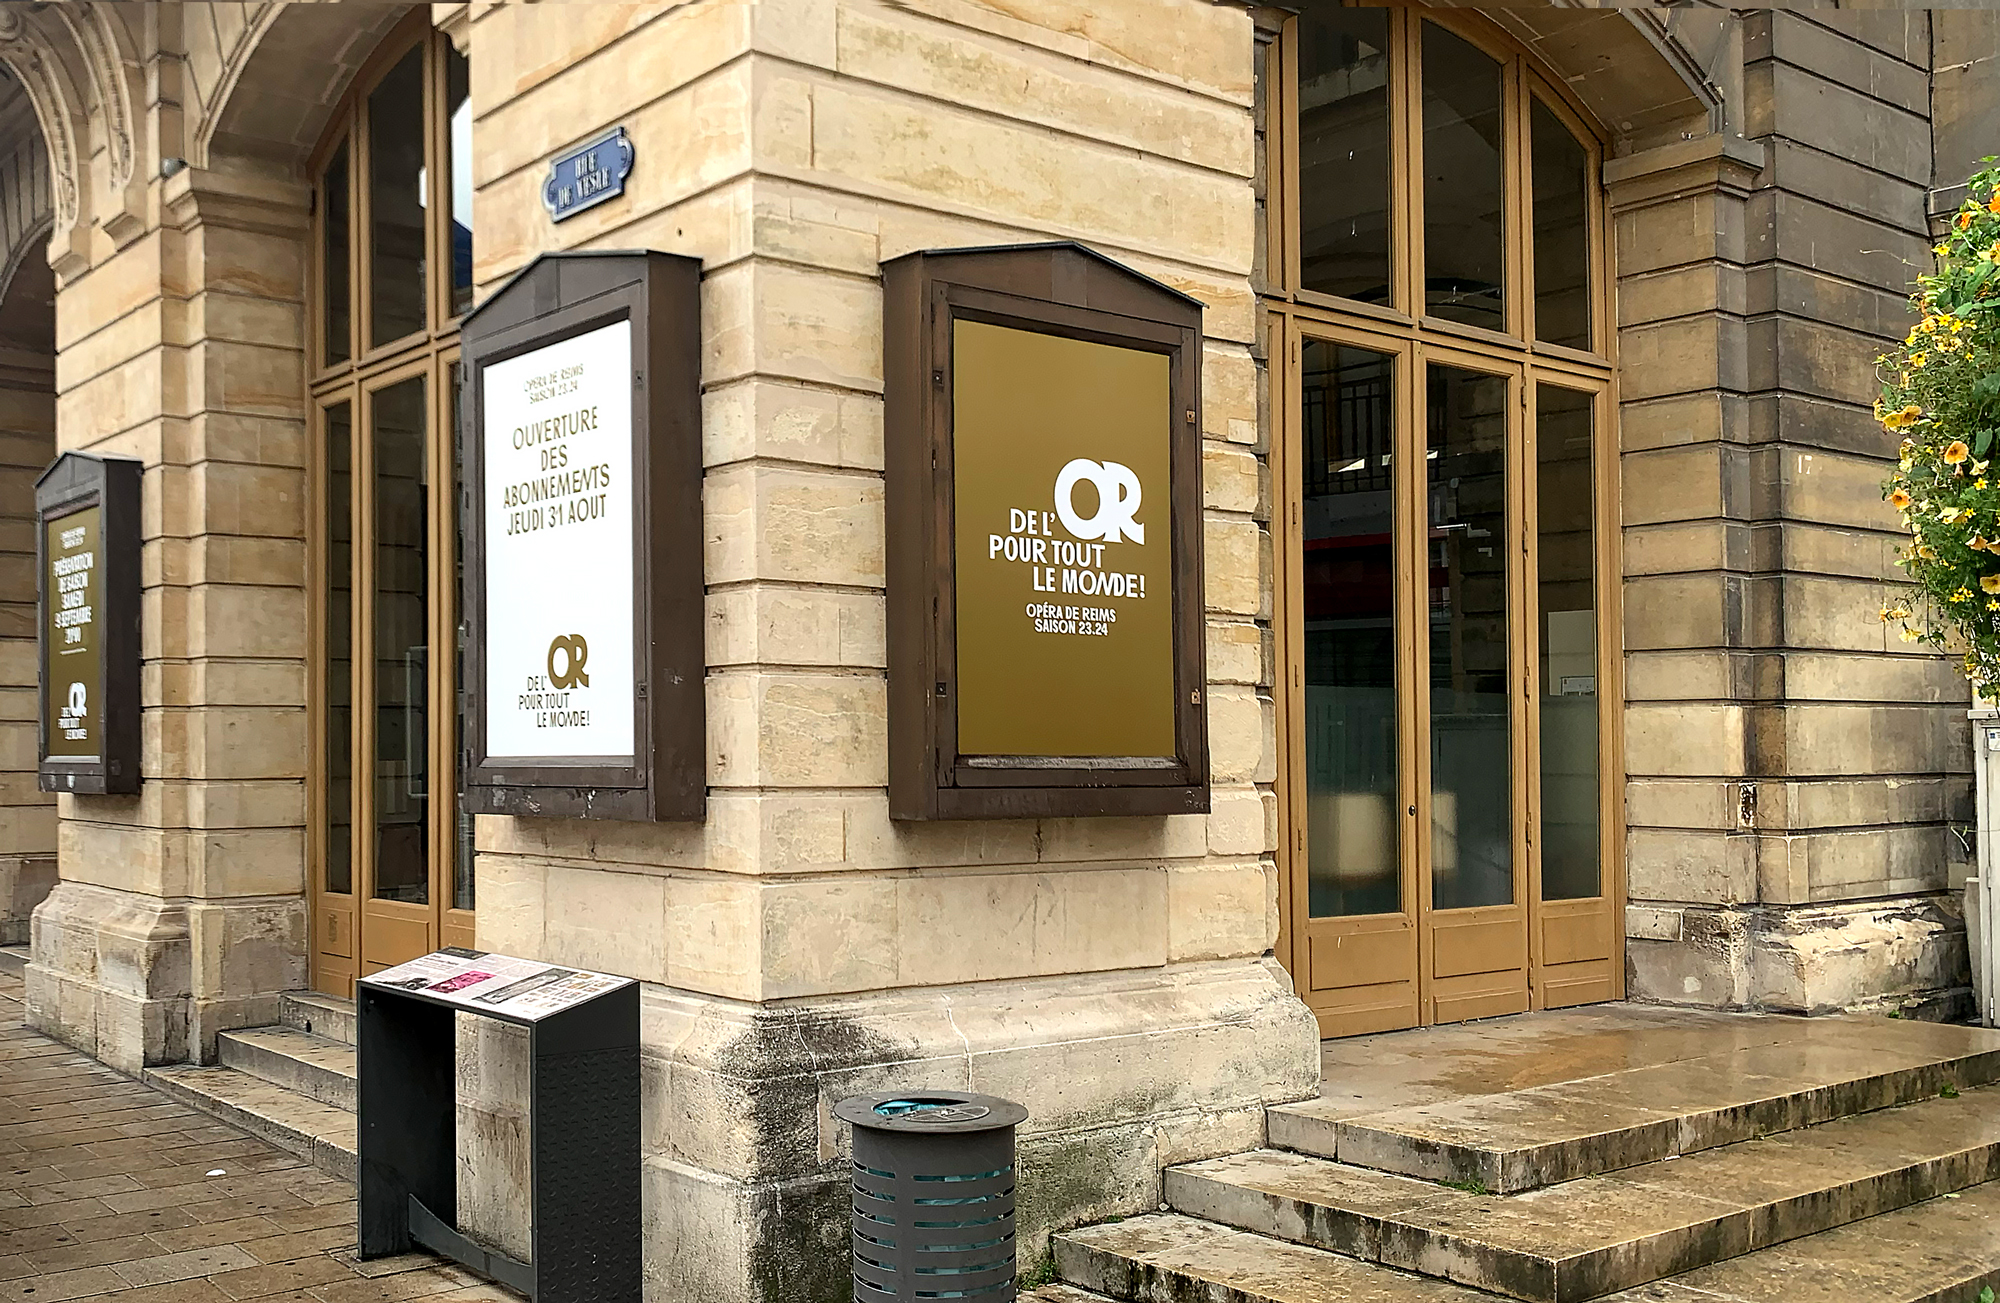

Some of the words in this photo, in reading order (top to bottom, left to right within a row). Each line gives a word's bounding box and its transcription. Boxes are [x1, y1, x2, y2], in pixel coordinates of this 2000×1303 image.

[513, 405, 598, 450] OUVERTURE
[541, 444, 568, 471] DES
[503, 463, 610, 509] ABONNEMENTS
[1054, 457, 1145, 545] OR
[507, 506, 544, 536] JEUDI
[548, 503, 563, 528] 31
[568, 493, 607, 524] AOUT
[1009, 508, 1038, 535] DE
[989, 534, 1048, 564] POUR
[1050, 540, 1106, 568] TOUT
[1033, 566, 1056, 592] LE
[1061, 569, 1146, 599] MONDE!
[1025, 601, 1062, 619] OPÉRA
[1065, 607, 1080, 620] DE
[1082, 608, 1117, 623] REIMS
[1034, 618, 1076, 634] SAISON
[1078, 621, 1109, 636] 23.24
[547, 633, 589, 690] OR
[527, 675, 539, 691] DE
[518, 693, 544, 710] POUR
[545, 692, 570, 709] TOUT
[537, 711, 547, 728] LE
[549, 710, 590, 727] MONDE!
